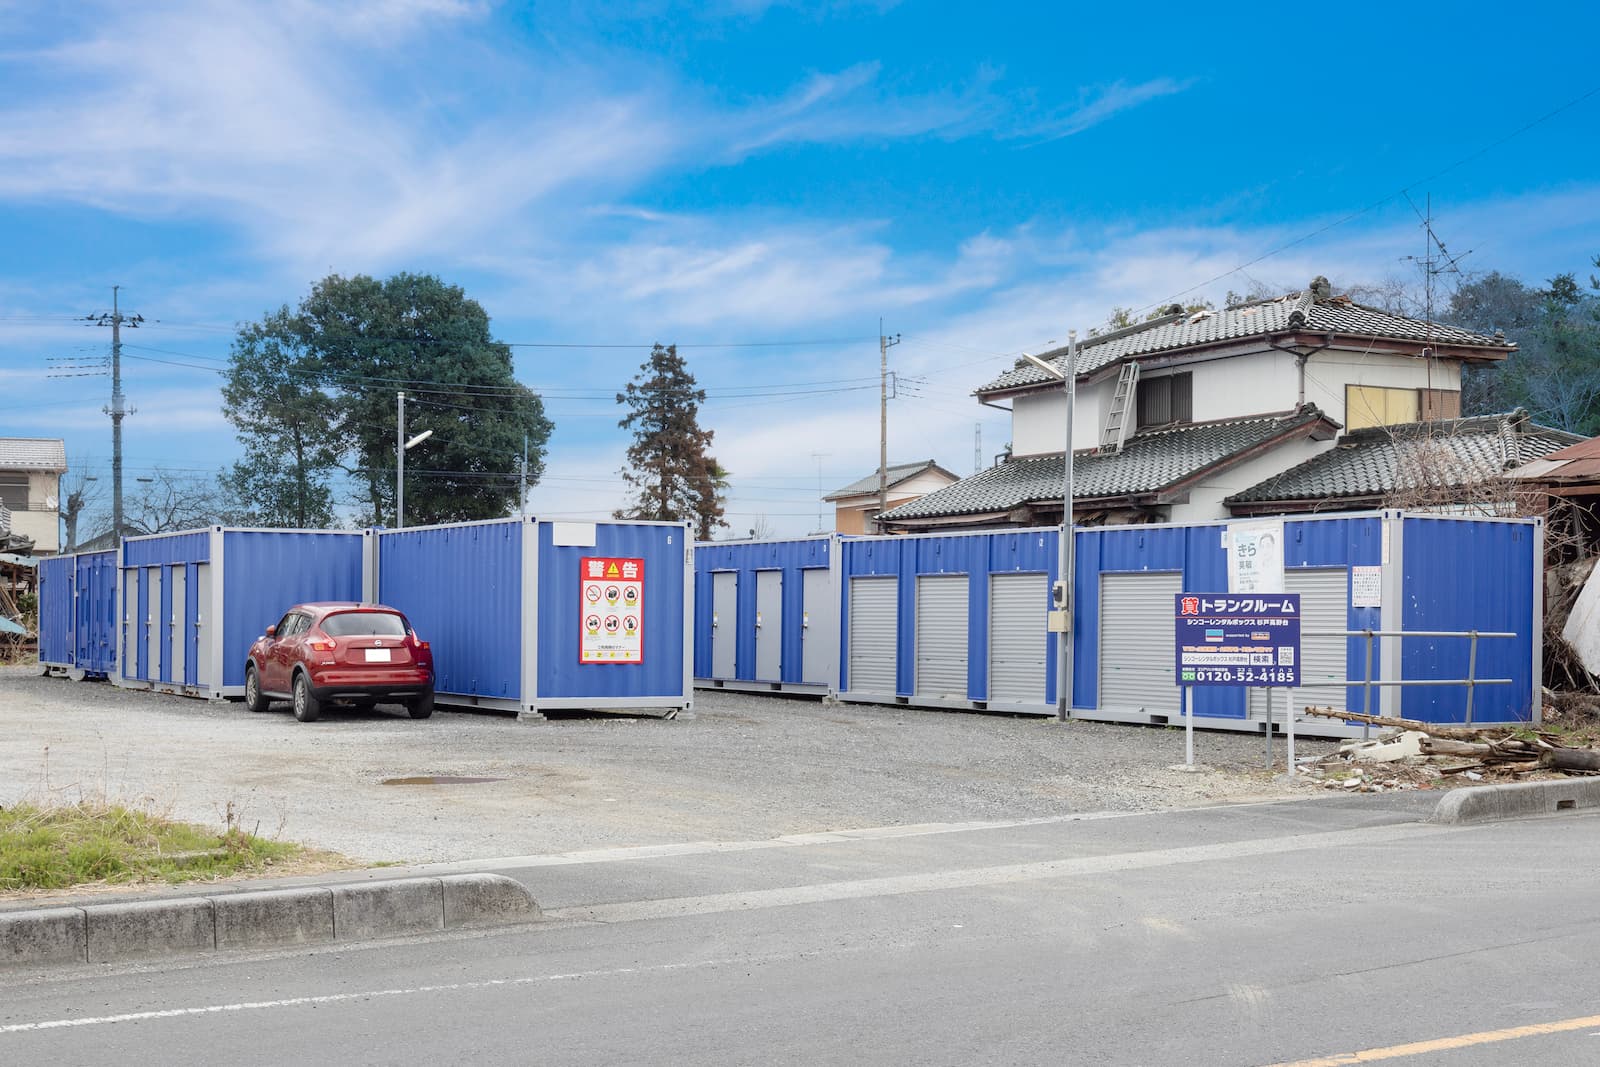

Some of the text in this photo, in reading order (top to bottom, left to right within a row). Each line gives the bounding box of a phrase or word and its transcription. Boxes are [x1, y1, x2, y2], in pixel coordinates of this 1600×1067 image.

[1238, 543, 1257, 558] きら
[622, 561, 639, 579] 告
[1201, 599, 1295, 613] トランクルーム
[1197, 671, 1294, 682] 0120-52-4185
